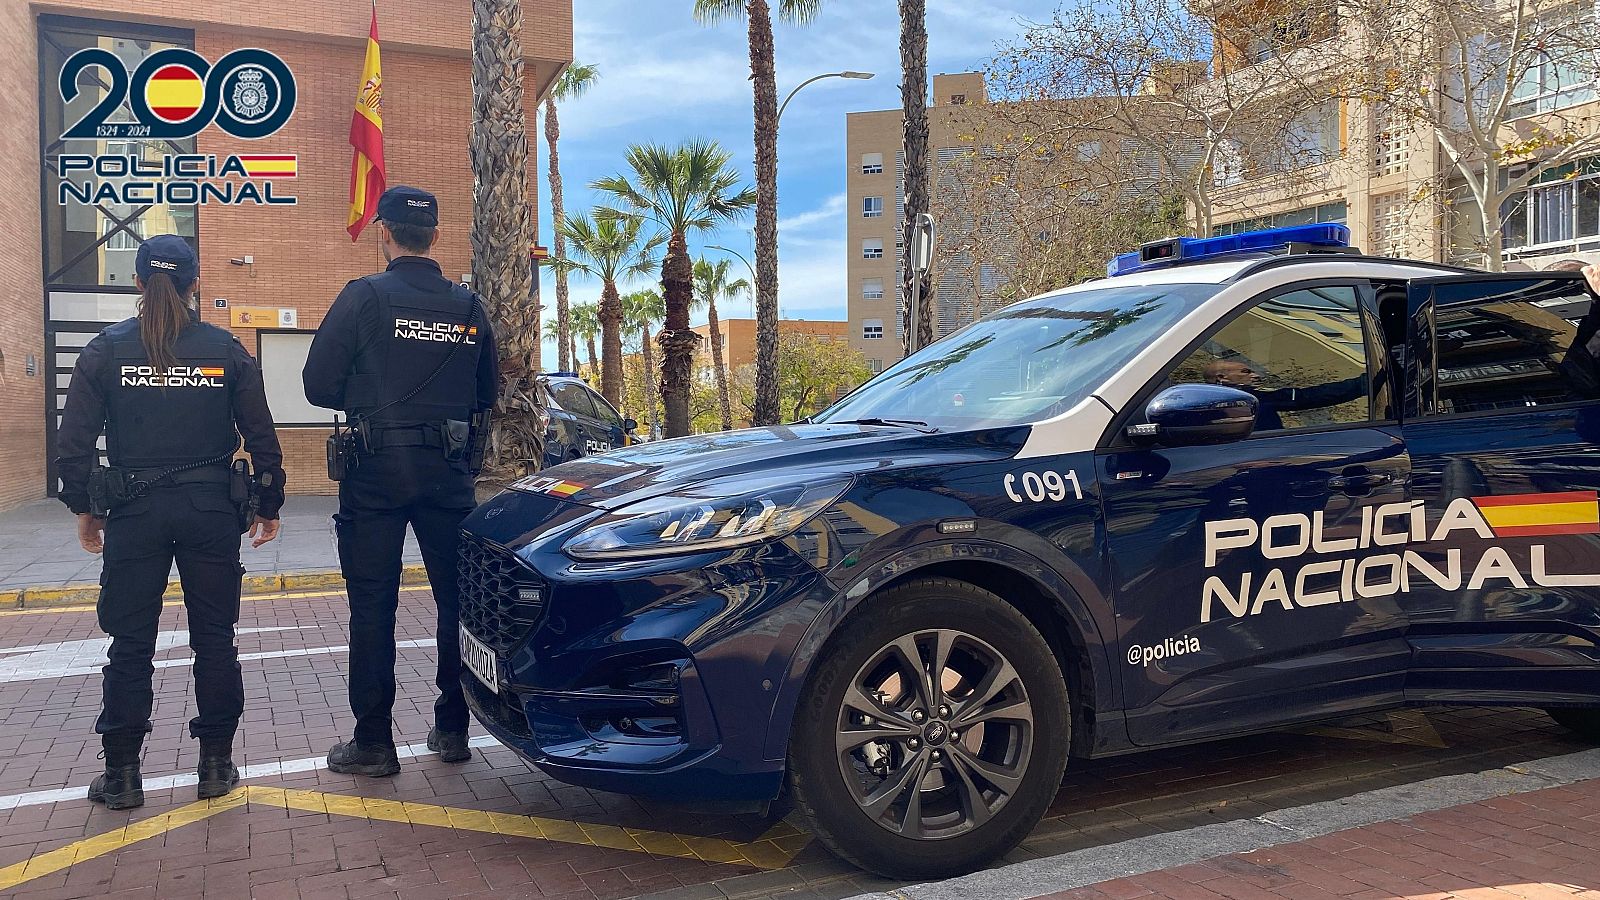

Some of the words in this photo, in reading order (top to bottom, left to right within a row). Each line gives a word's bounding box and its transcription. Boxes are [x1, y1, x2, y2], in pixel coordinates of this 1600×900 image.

[121, 376, 224, 387] NACIONAL
[1022, 469, 1083, 502] 091
[1200, 544, 1600, 622] NACIONAL
[1127, 634, 1201, 667] @policia
